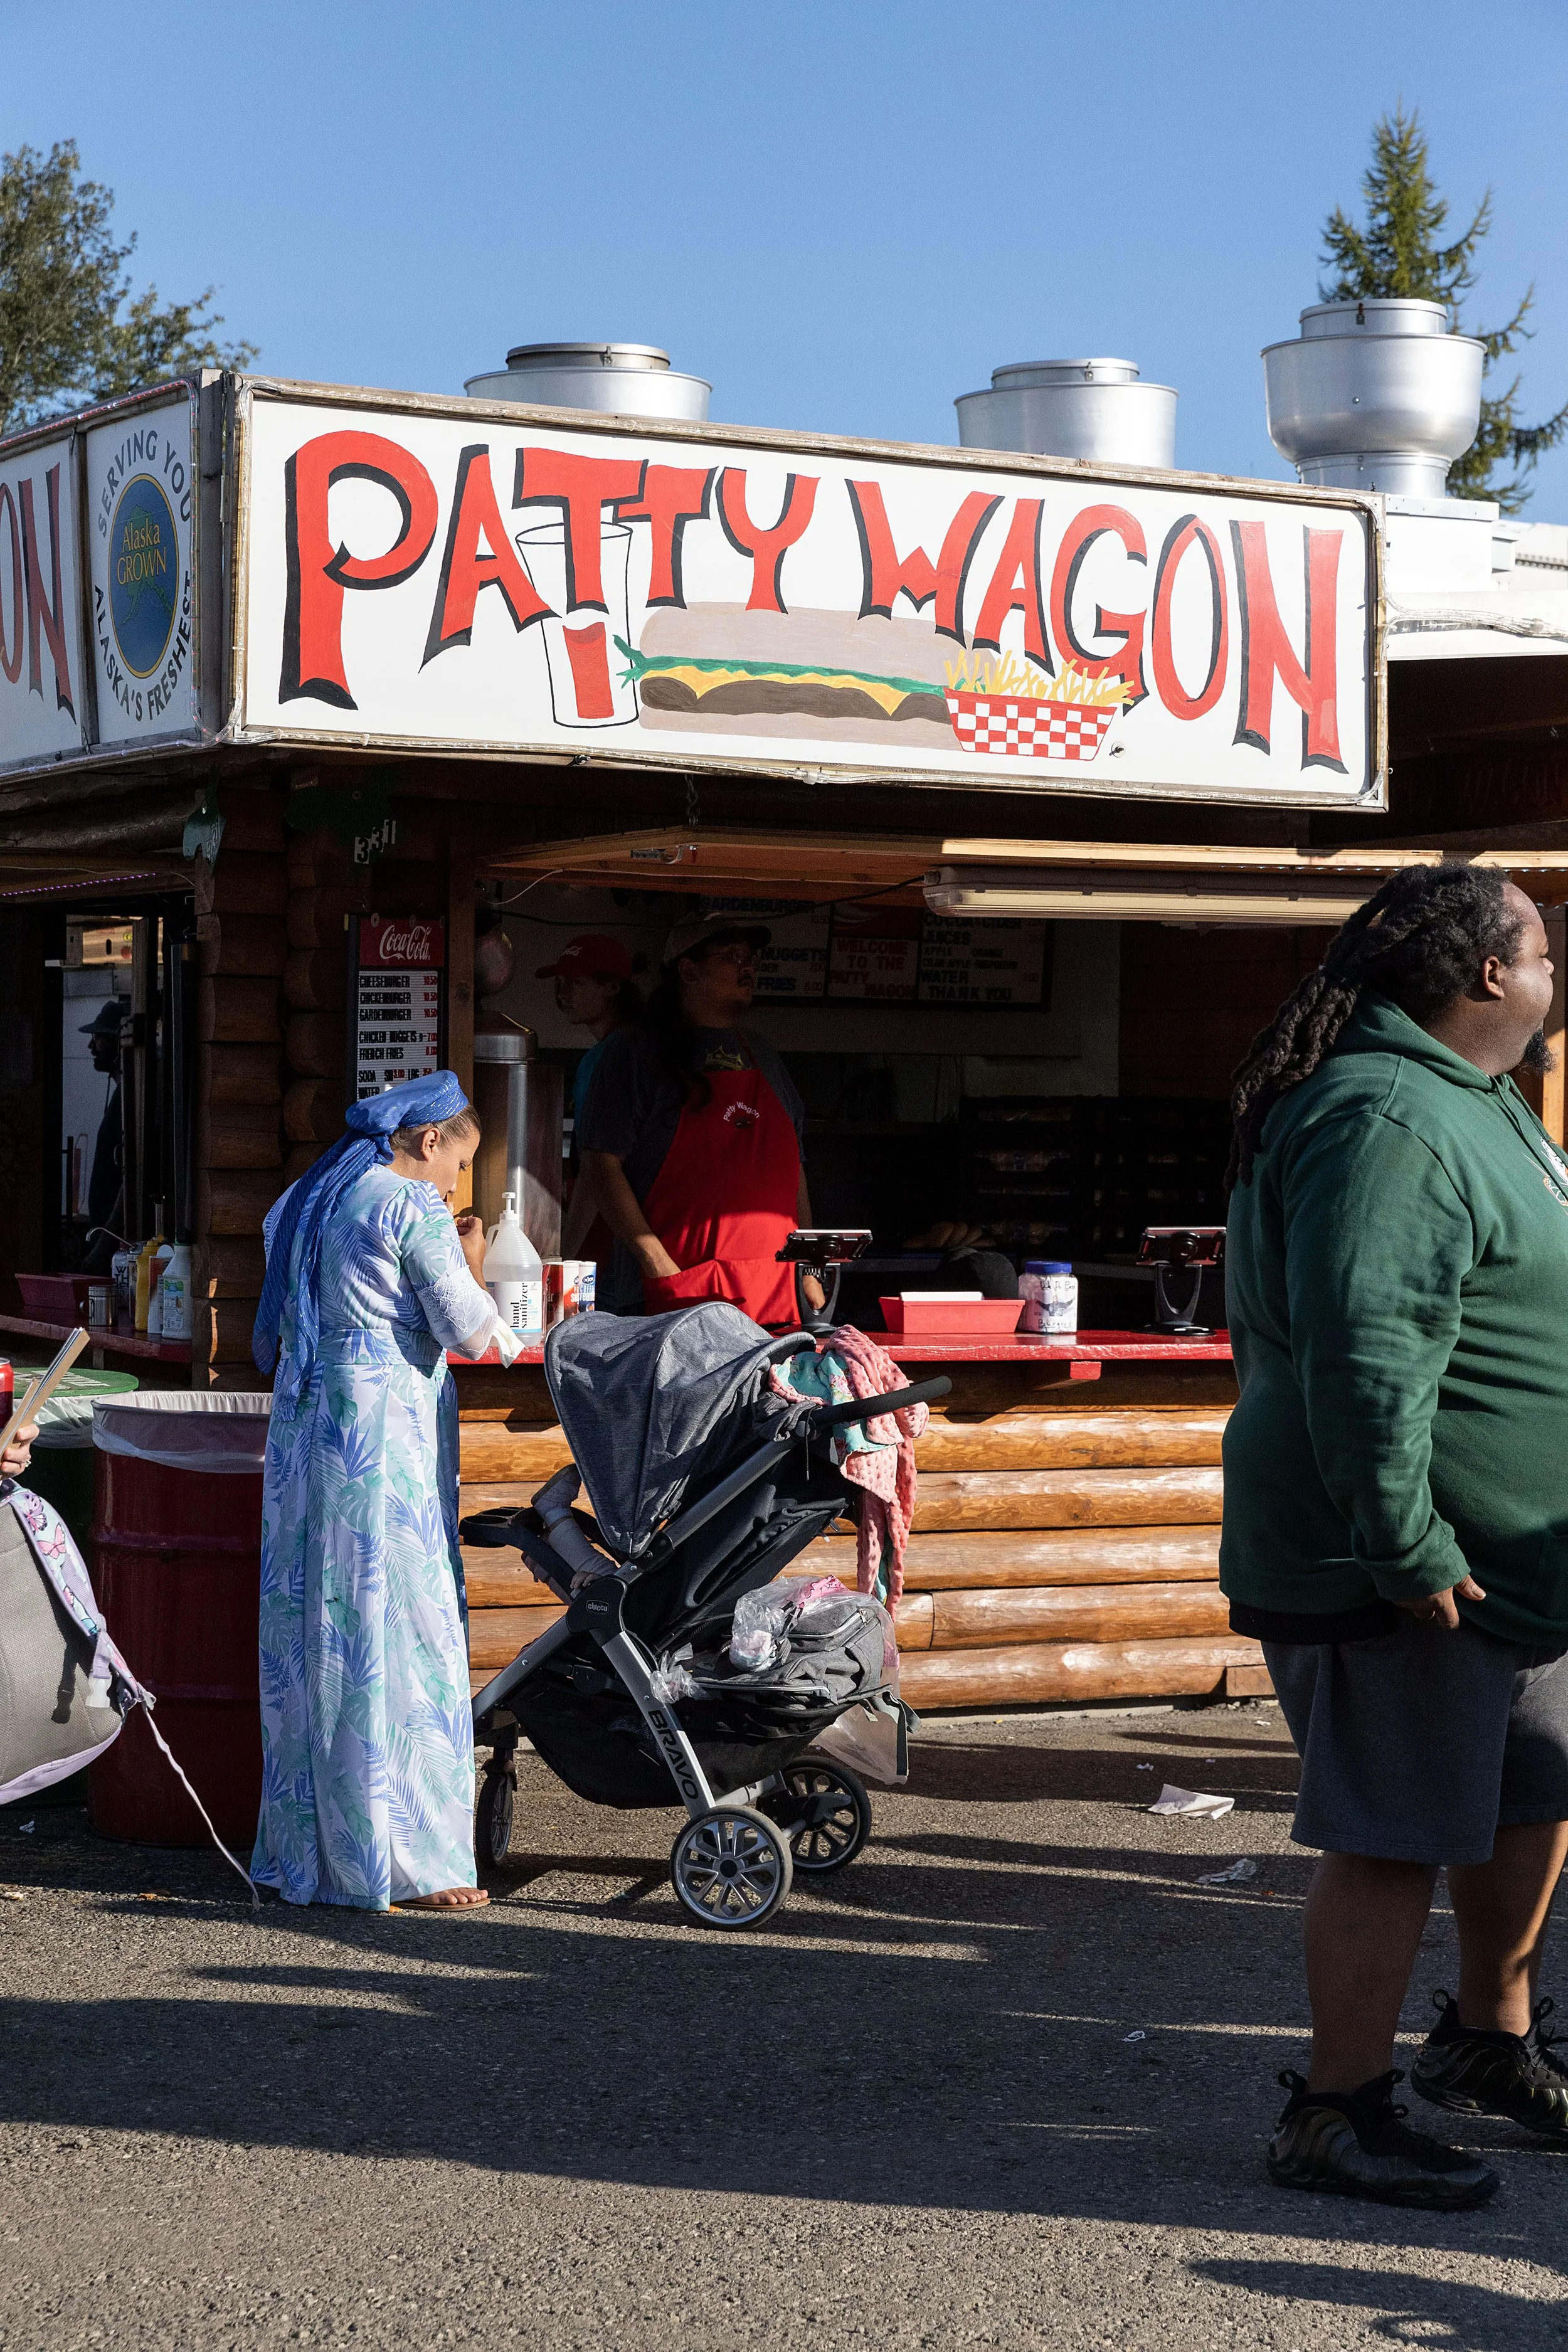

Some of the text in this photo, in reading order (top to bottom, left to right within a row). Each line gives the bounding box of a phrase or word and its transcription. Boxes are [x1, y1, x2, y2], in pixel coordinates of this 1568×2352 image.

[98, 429, 191, 538] SERVING YOU
[122, 517, 161, 553] Alaska
[117, 546, 166, 585] GROWN
[279, 430, 1349, 774] PATTY WAGON
[95, 570, 192, 721] ALASKA'S FRESHEST
[357, 819, 393, 862] 331
[379, 924, 431, 961] Coca-Cola
[924, 931, 971, 945] JUICES
[837, 939, 909, 955] WELCOME
[924, 947, 953, 956] APPLE
[761, 948, 828, 961] NUGGETS
[848, 955, 904, 970] TO THE
[359, 975, 411, 988] CHEESEBURGER
[757, 977, 797, 990] FRIES
[830, 970, 870, 984] PATTY
[919, 970, 968, 983] WATER
[865, 983, 916, 998] WAGON
[928, 986, 1012, 1000] THANK YOU
[359, 992, 411, 1004] CHICKENBURGER
[359, 1009, 411, 1021] GARDENBURGER
[359, 1030, 386, 1044] CHICKEN
[389, 1030, 417, 1042] NUGGETS
[359, 1047, 384, 1060] FRENCH
[386, 1046, 404, 1059] FRIES
[358, 1069, 376, 1083] SODA
[358, 1086, 380, 1099] WATER
[723, 1101, 760, 1122] Patty Wagon
[519, 1282, 528, 1328] sanitizer
[510, 1302, 519, 1328] hand
[588, 1602, 608, 1612] chicco
[648, 1710, 699, 1799] BRAVO
